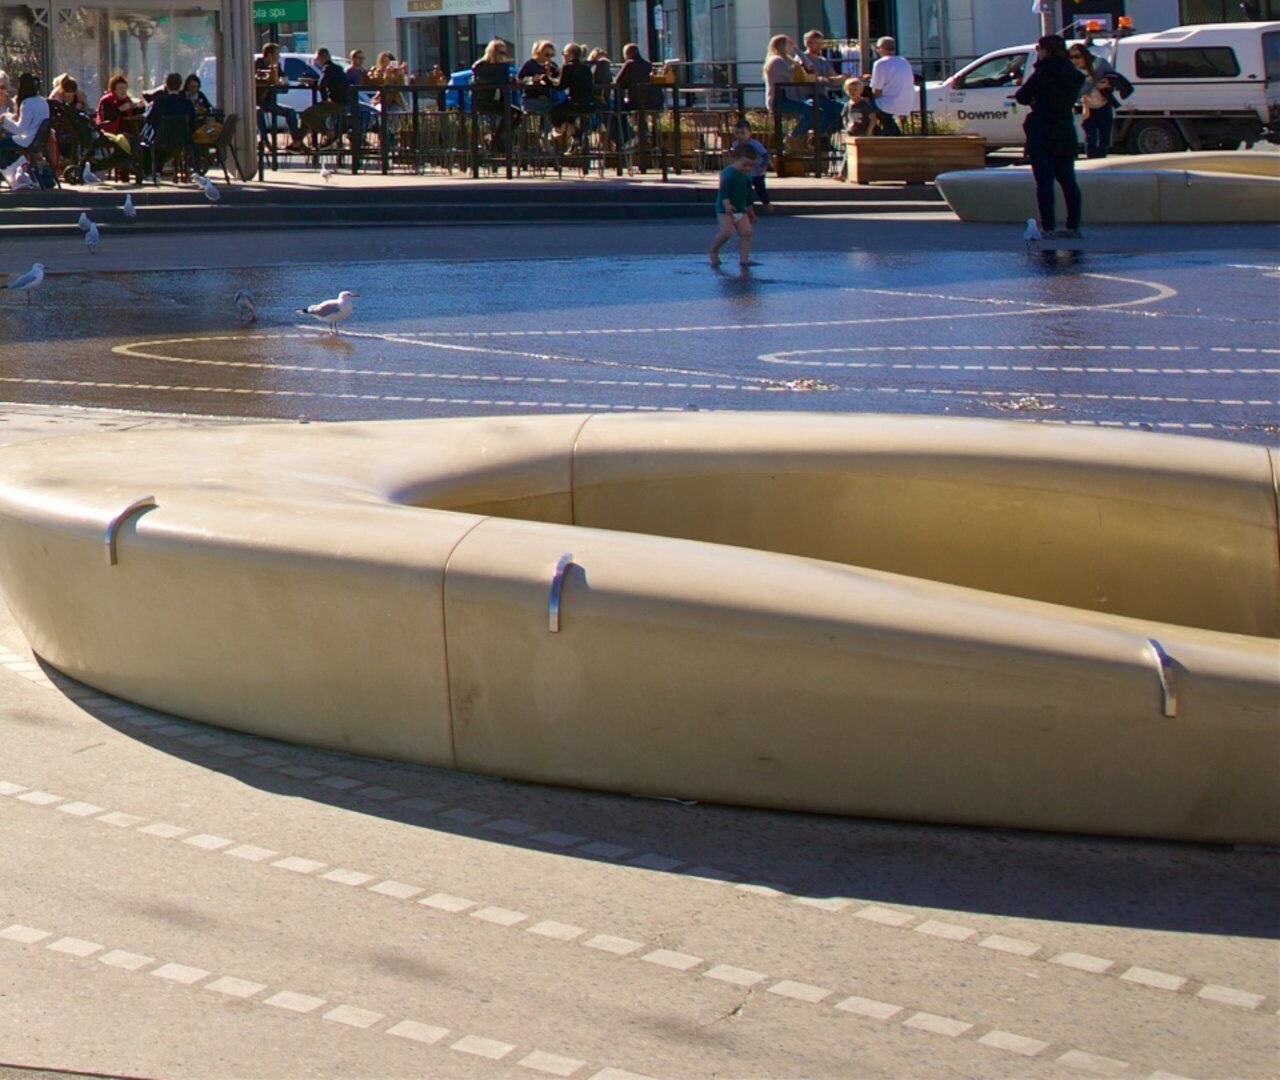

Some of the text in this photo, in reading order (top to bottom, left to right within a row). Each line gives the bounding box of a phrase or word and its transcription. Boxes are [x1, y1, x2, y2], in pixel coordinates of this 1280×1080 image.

[413, 1, 438, 11] SILK
[269, 8, 286, 19] spa
[957, 110, 1009, 120] Downer
